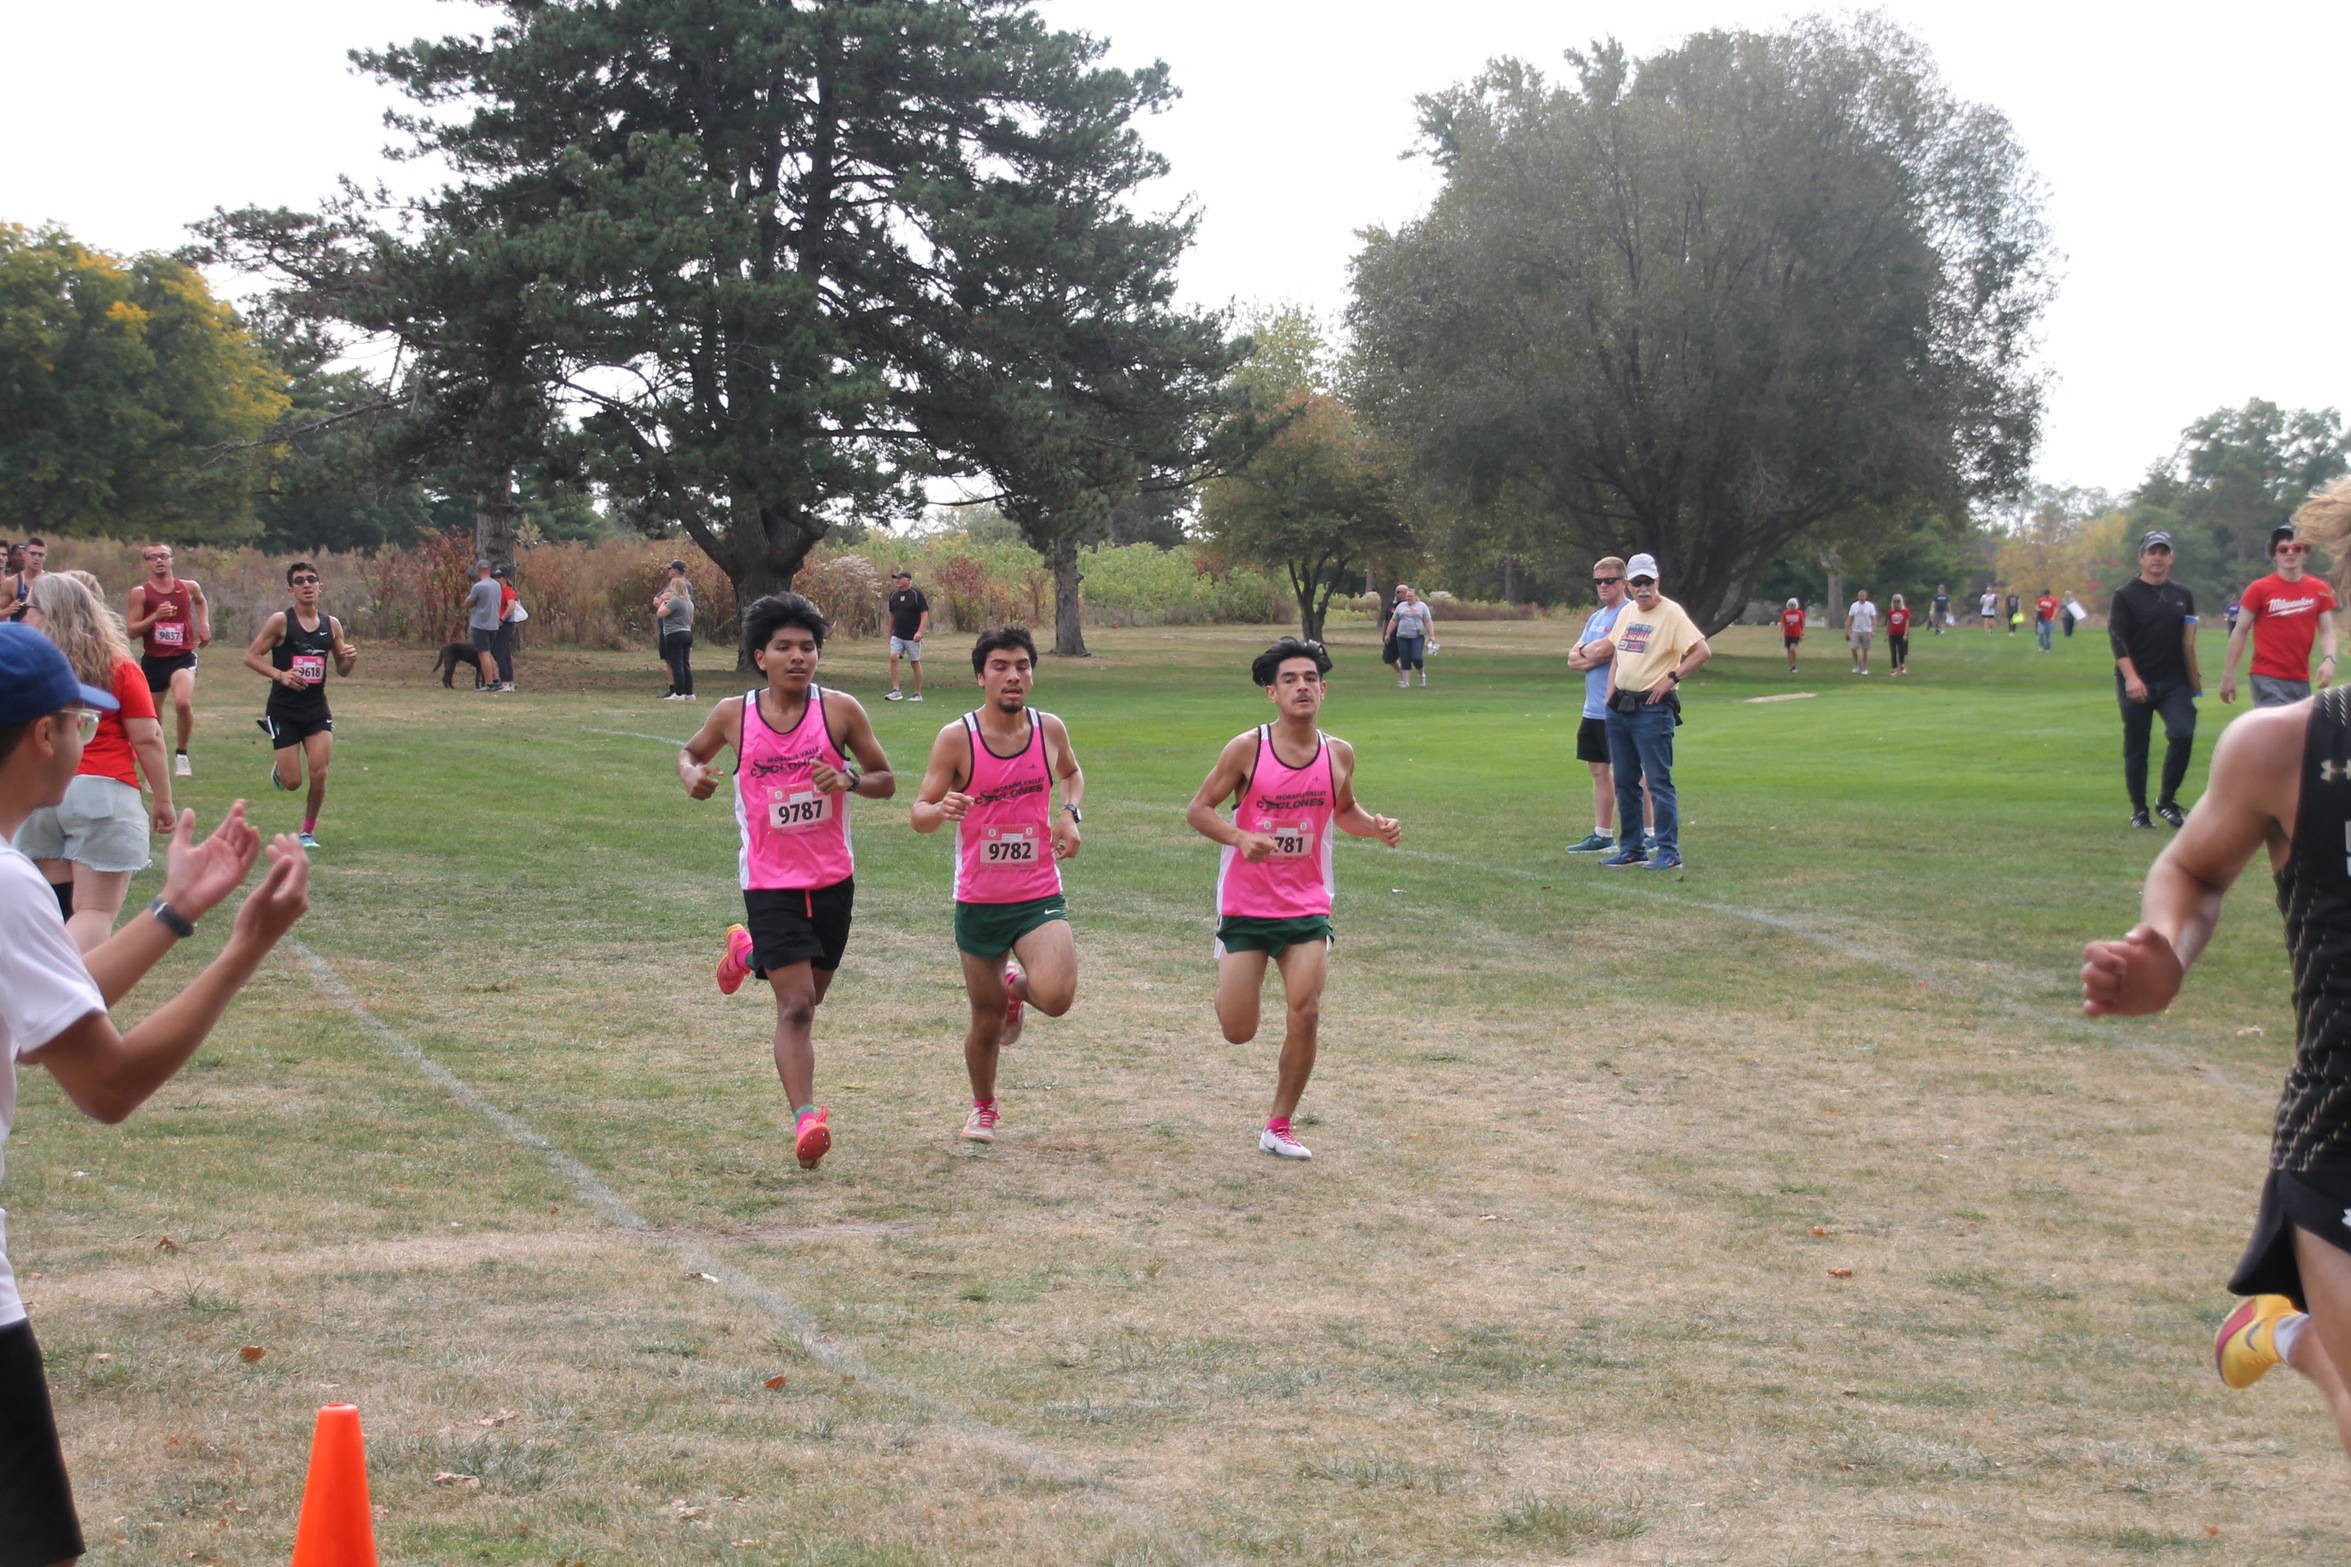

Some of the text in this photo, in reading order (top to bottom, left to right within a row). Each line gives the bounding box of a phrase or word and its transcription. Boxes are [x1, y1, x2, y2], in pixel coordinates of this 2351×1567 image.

[159, 631, 180, 641] 9857
[298, 666, 321, 678] 9618
[778, 799, 823, 825] 9787
[988, 842, 1031, 860] 9782
[1269, 835, 1304, 853] 781
